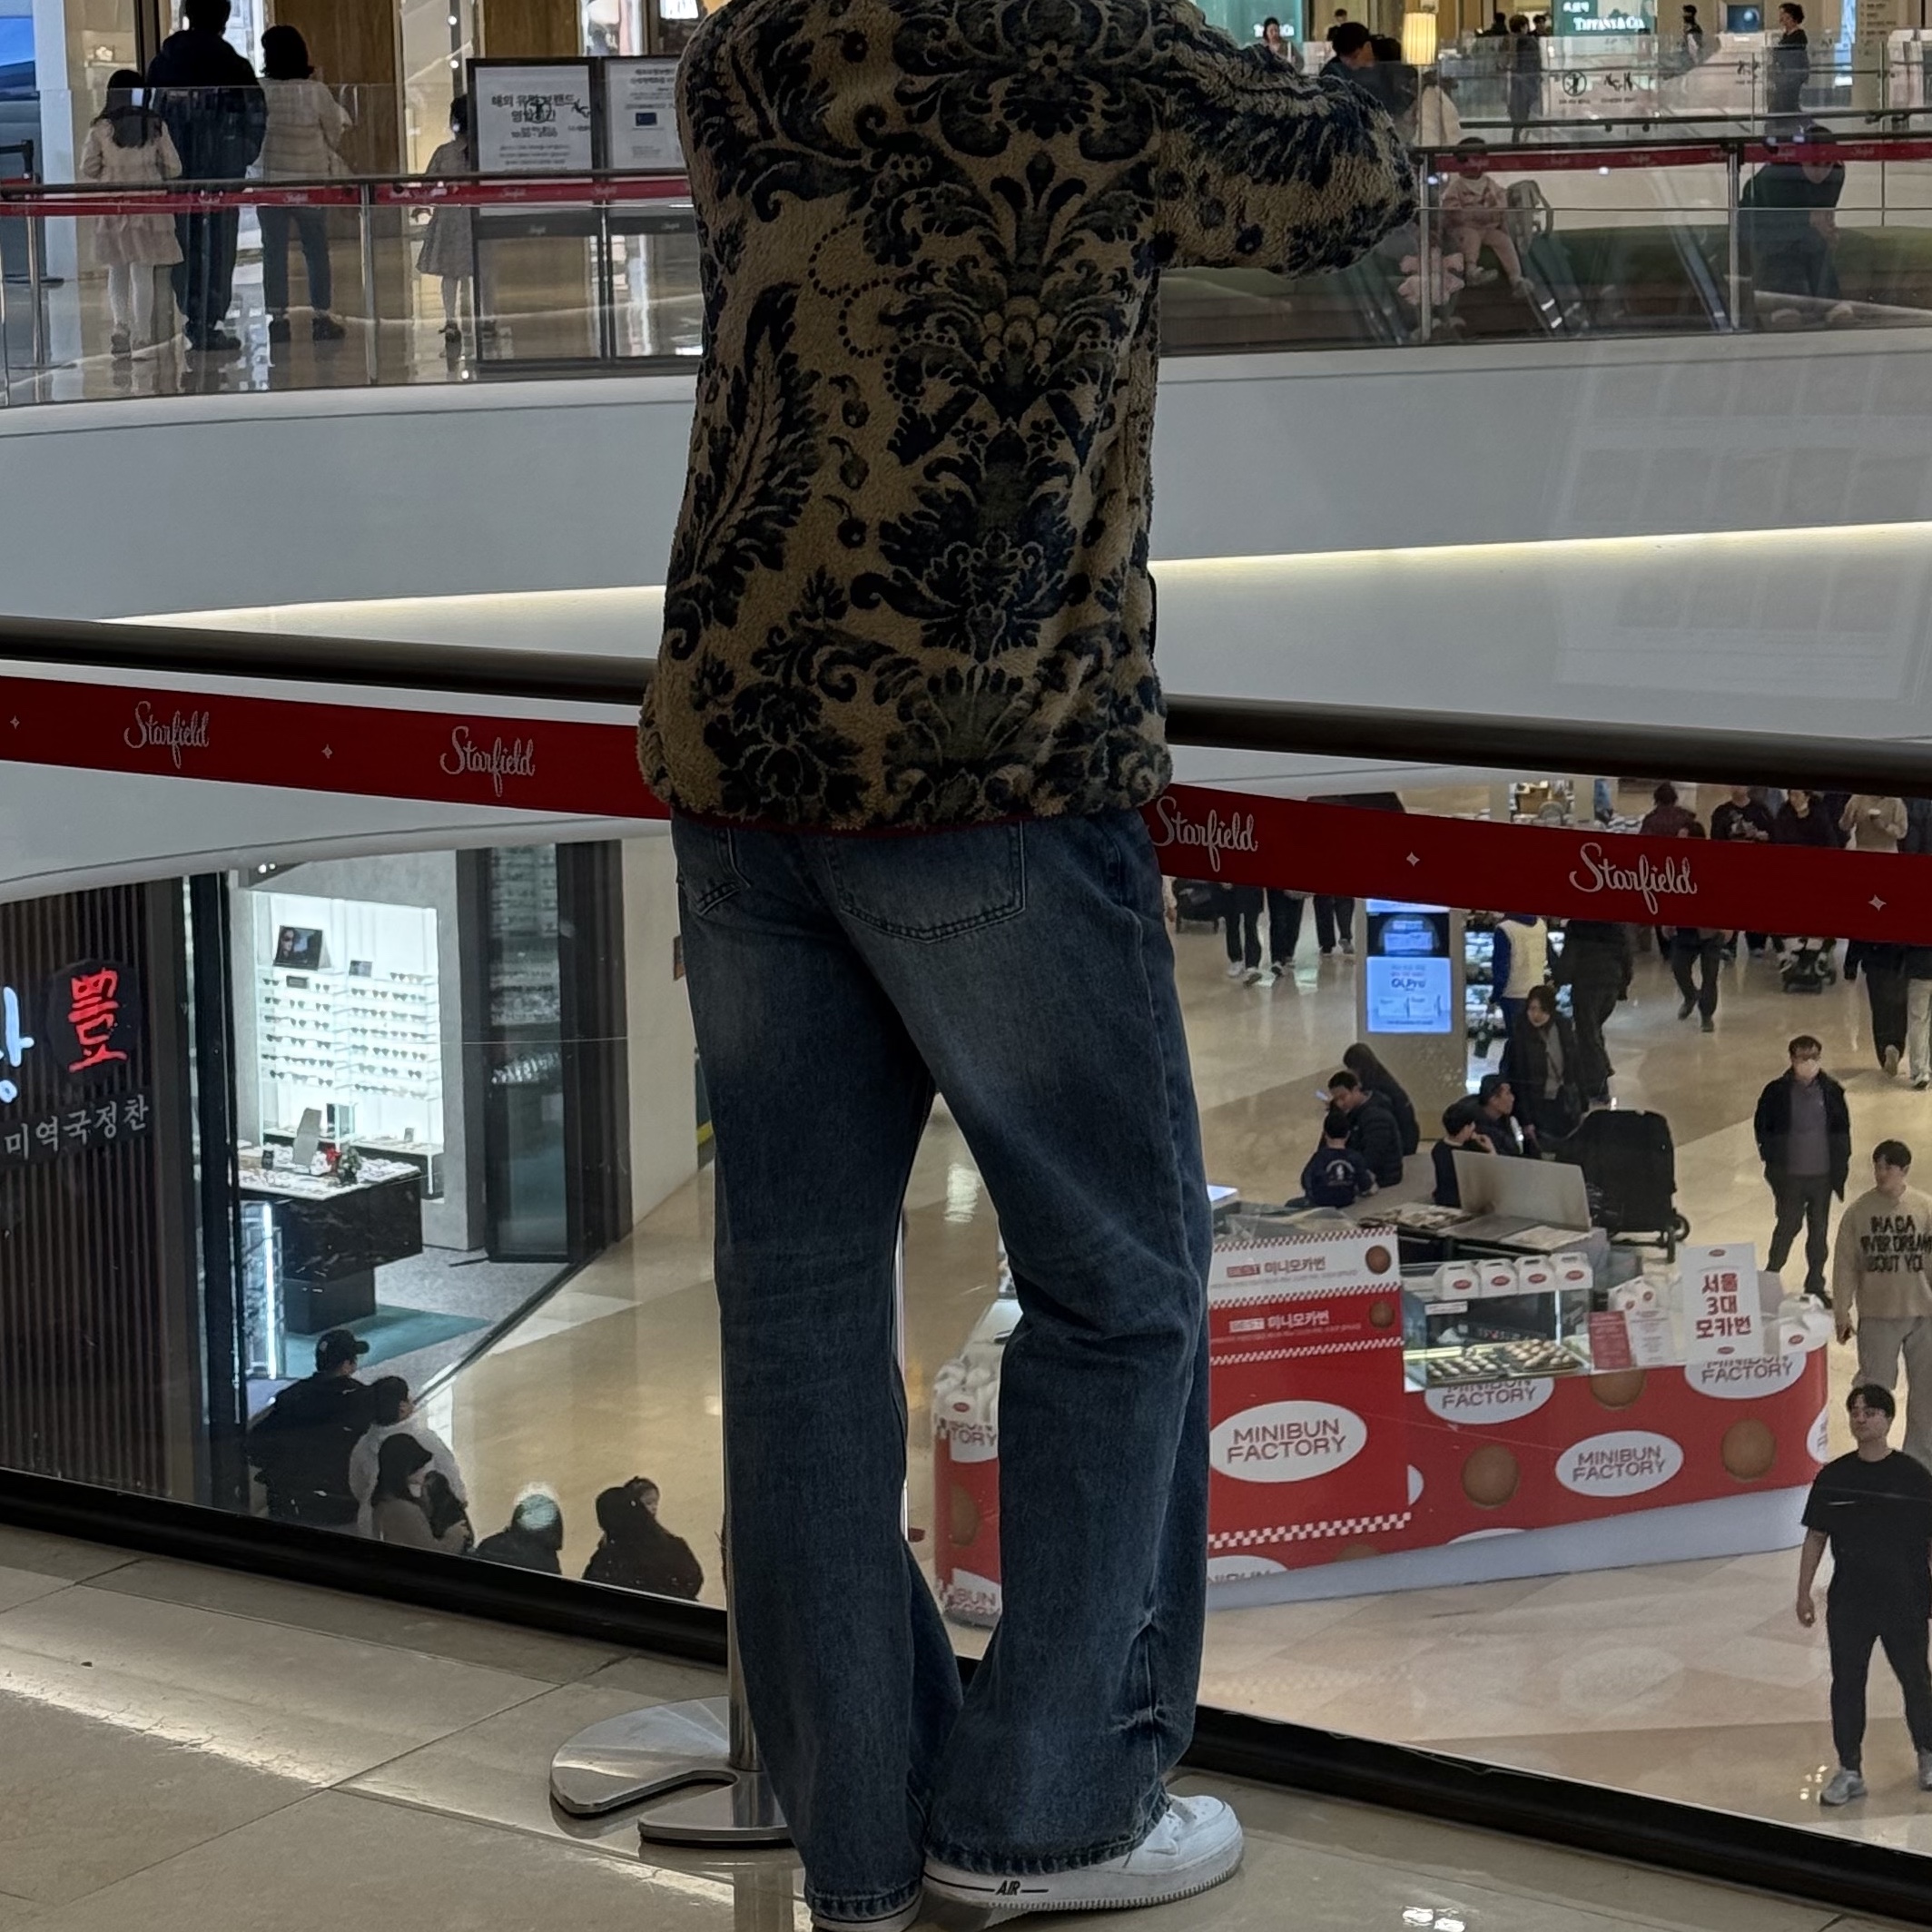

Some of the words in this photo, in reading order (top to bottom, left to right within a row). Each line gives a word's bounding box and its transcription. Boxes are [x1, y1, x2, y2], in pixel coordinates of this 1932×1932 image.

[123, 700, 210, 769] Starfield
[439, 725, 536, 797] Starfield
[1148, 795, 1258, 872] Starfield
[1569, 842, 1698, 915] Starfield
[5, 1094, 149, 1159] 미역국정찬
[1702, 1273, 1738, 1294] 서울
[1707, 1296, 1738, 1316] 3대
[1696, 1316, 1752, 1339] 모카번
[1701, 1362, 1793, 1384] FACTORY
[1442, 1386, 1536, 1409] FACTORY
[1233, 1418, 1340, 1445] MINIBUN
[1227, 1434, 1346, 1464] FACTORY
[1578, 1445, 1661, 1466] MINIBUN
[1572, 1460, 1666, 1482] FACTORY
[996, 1880, 1021, 1896] AIR
